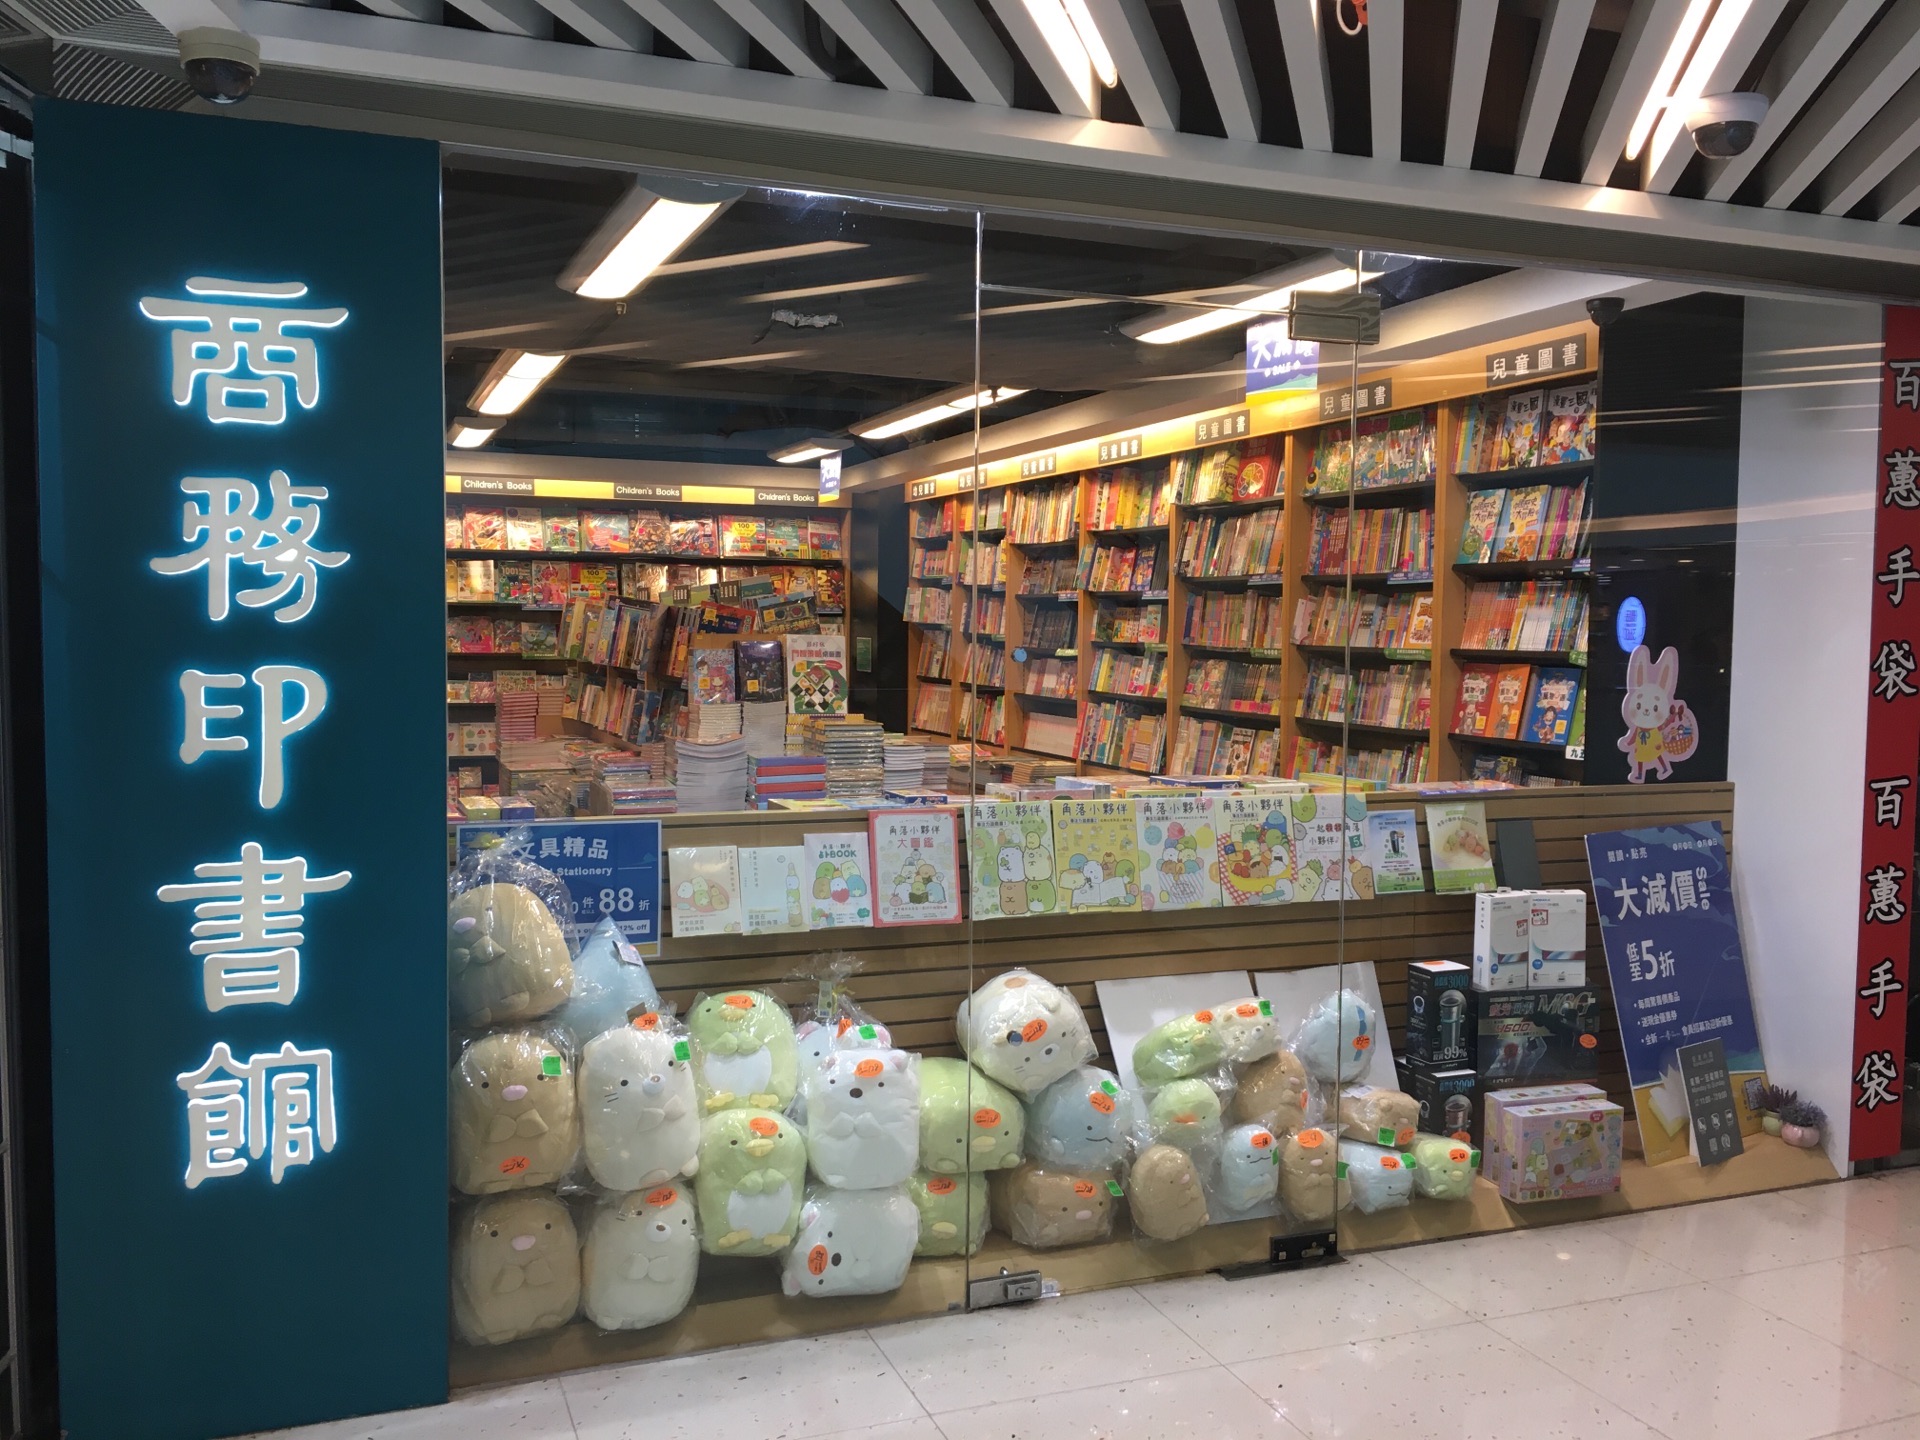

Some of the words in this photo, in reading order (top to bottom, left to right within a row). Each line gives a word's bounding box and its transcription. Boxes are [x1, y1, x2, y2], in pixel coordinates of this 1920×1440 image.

[1491, 342, 1578, 381] 兒童圖書
[1323, 384, 1387, 416] 兒童圖書
[1198, 414, 1247, 440] 兒童圖書
[1100, 438, 1139, 462] 兒童圖書
[1022, 458, 1055, 477] 兒童圖書
[464, 479, 503, 490] Children's
[506, 481, 533, 492] Books
[958, 470, 986, 490] 幼兒書
[616, 486, 653, 496] Children's
[655, 487, 680, 497] Books
[758, 492, 791, 502] Children's
[793, 494, 815, 503] Books
[501, 566, 518, 575] 1001
[138, 277, 352, 1188] 商務印書館
[973, 805, 1042, 820] 角落小夥伴
[1062, 802, 1128, 816] 角落小夥伴
[1143, 802, 1207, 816] 角落小夥伴
[1222, 799, 1285, 813] 角落小夥伴
[889, 825, 941, 836] 角落小夥伴
[517, 836, 609, 860] 文具精品
[1353, 836, 1360, 846] 5
[556, 866, 613, 876] Stationery
[582, 896, 594, 909] 件
[599, 887, 634, 913] 88
[638, 899, 650, 911] 折
[1613, 870, 1699, 921] 大減價
[1696, 866, 1711, 911] Sale
[636, 923, 647, 931] off
[1856, 777, 1911, 1109] 百蕙手袋
